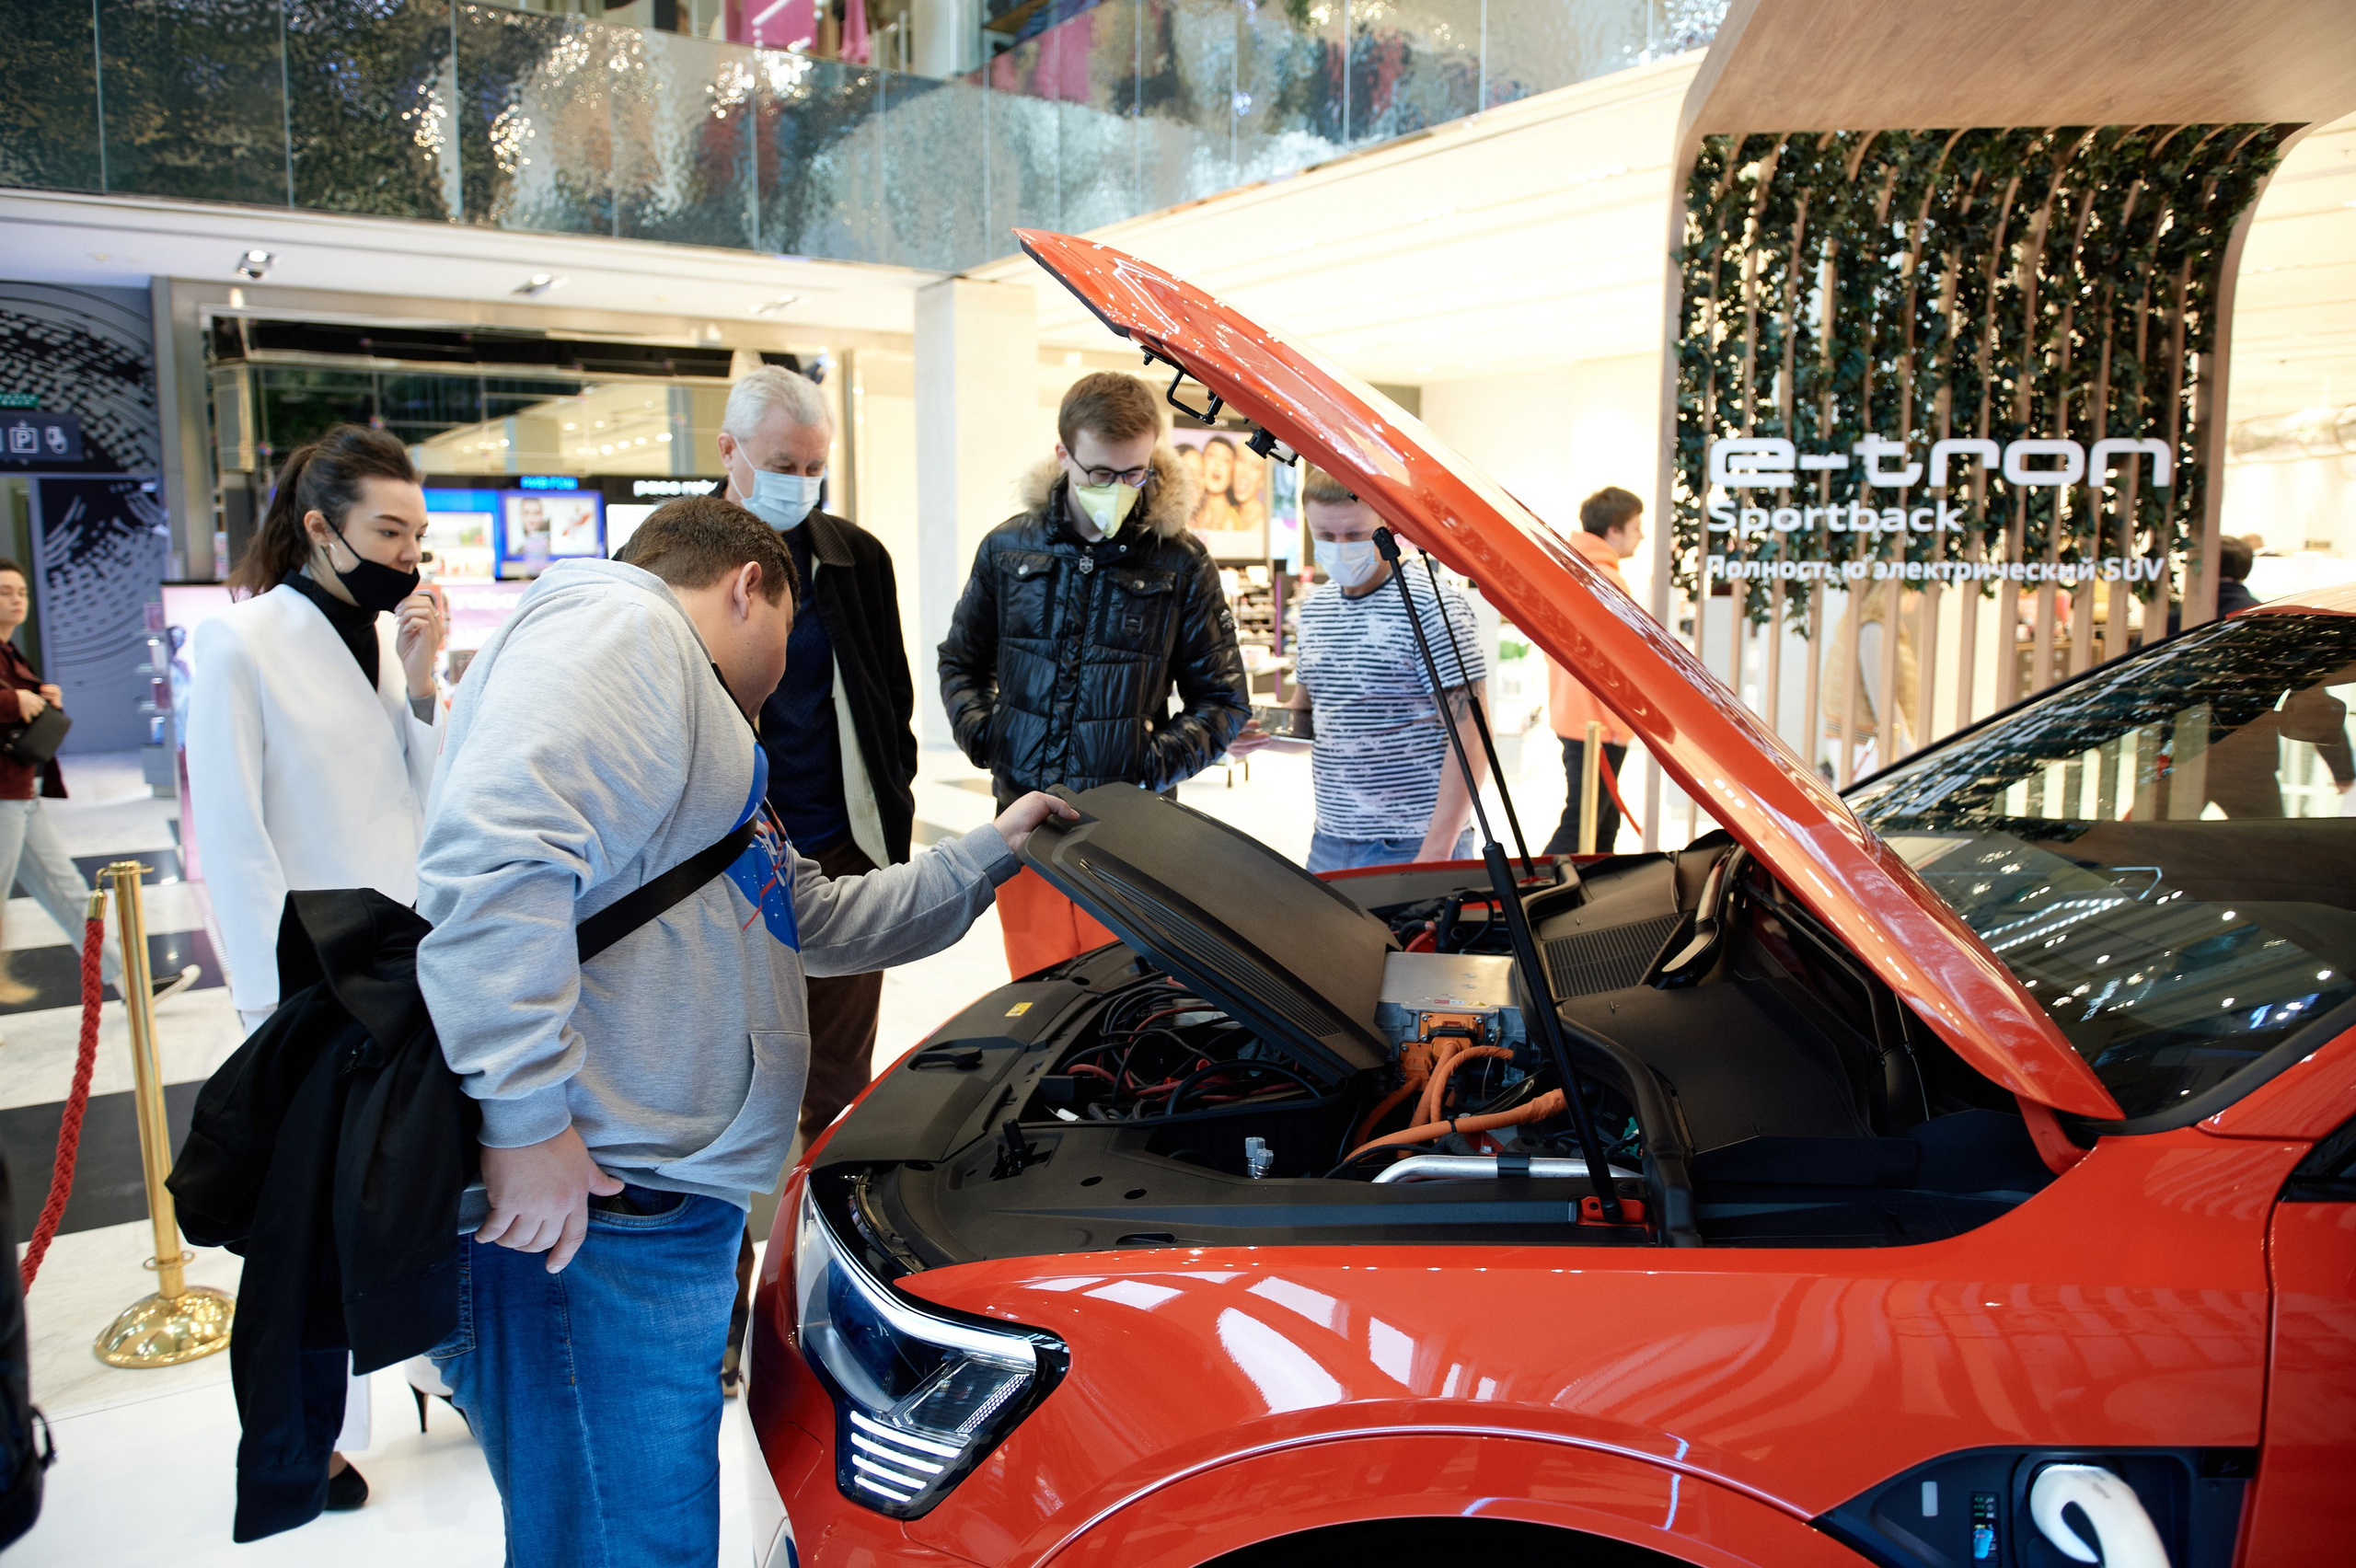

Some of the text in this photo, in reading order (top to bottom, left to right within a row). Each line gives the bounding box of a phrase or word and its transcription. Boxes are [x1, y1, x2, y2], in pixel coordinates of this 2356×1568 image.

[1709, 433, 2172, 488] e-tron
[1707, 501, 1964, 539] Sportback
[1706, 555, 2165, 585] Полностью электрический SUV
